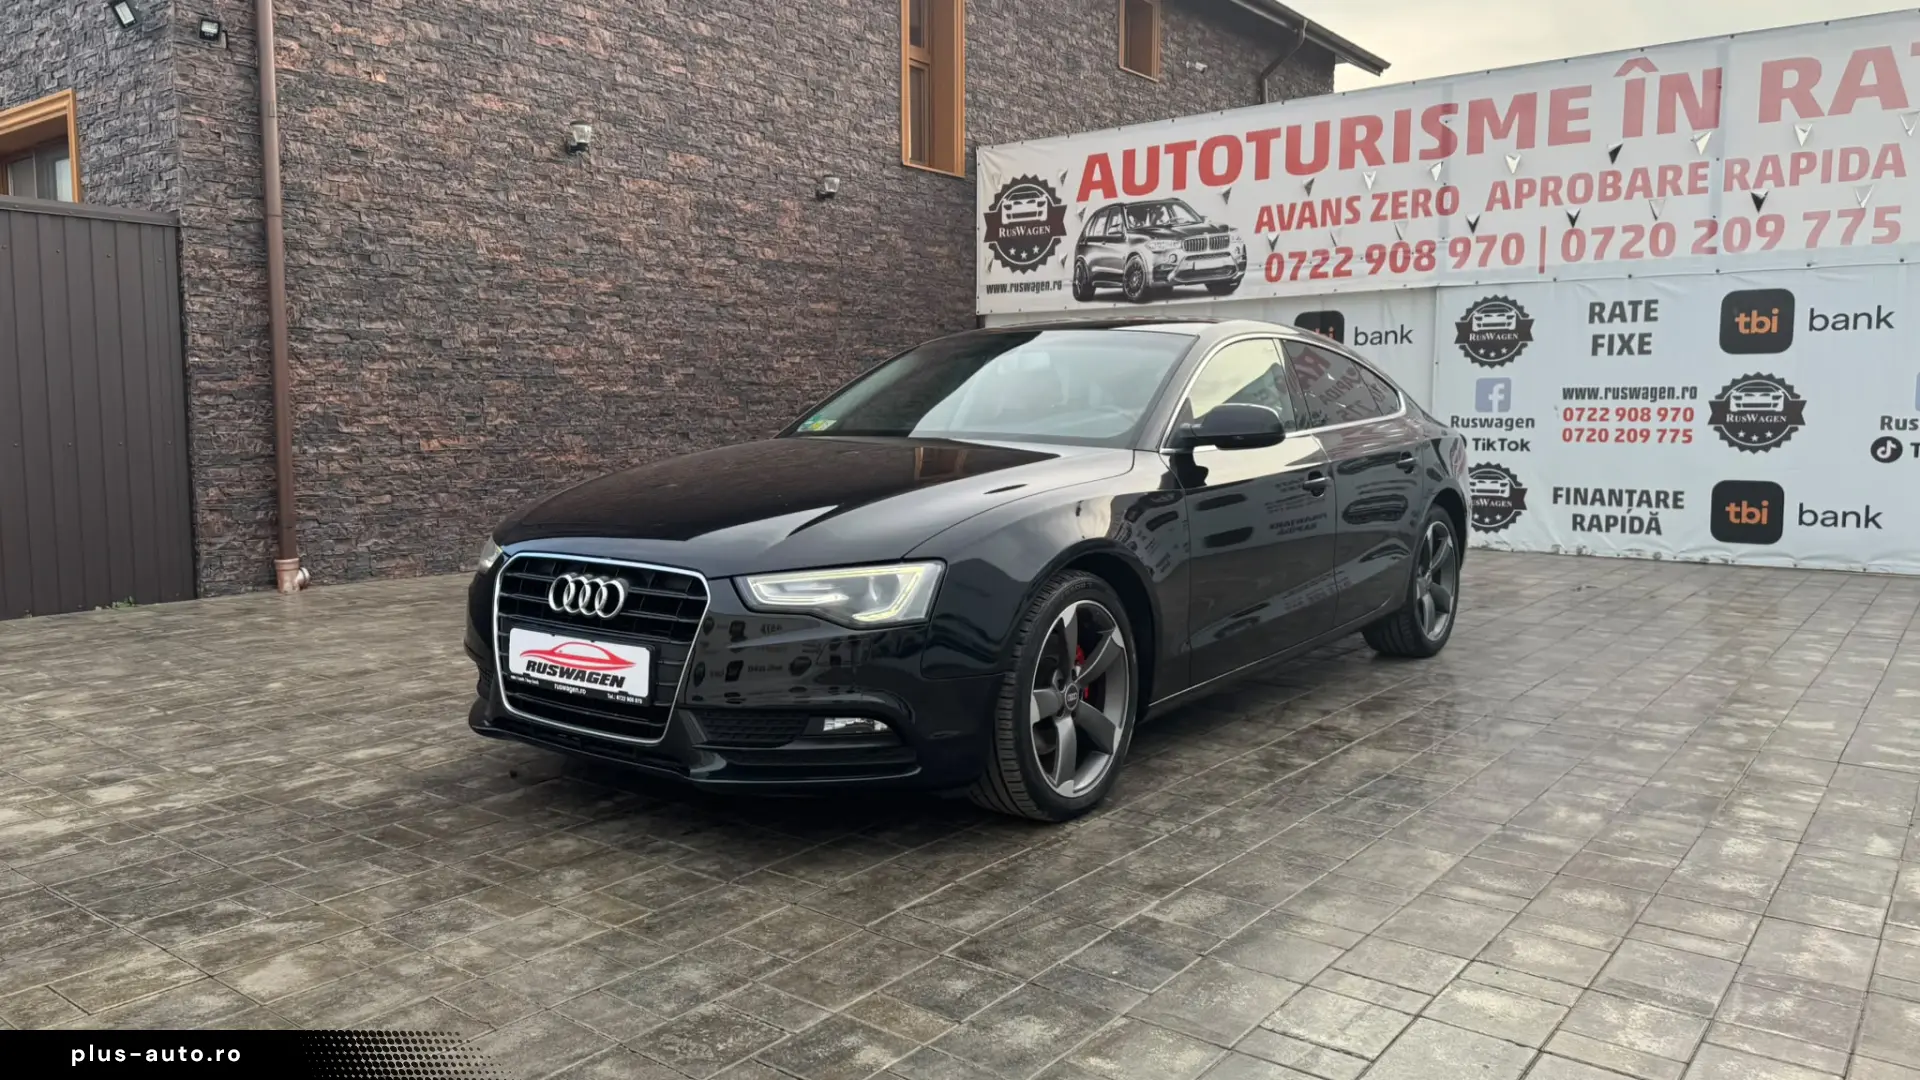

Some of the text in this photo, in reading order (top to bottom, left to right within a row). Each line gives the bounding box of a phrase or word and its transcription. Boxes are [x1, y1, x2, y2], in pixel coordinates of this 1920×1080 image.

[1076, 42, 1920, 201] AUTOTURISME ÎN RA
[1254, 143, 1906, 234] AVANS ZERO APROBARE RAPIDA
[1264, 246, 1354, 283] 0722
[1364, 240, 1437, 275] 908
[1448, 232, 1525, 269] 970
[1560, 222, 1676, 262] 0720
[1690, 213, 1785, 255] 209
[1802, 206, 1901, 249] 775
[986, 280, 1062, 295] www.ruswagen.ro
[1588, 299, 1659, 324] RATE
[1735, 305, 1895, 335] tbi bank
[1354, 324, 1414, 346] bank
[1591, 332, 1652, 356] FIXE
[1562, 386, 1698, 403] www.ruswagen.ro
[1450, 415, 1535, 431] Ruswagen
[1562, 407, 1695, 422] 0722 908 970
[1472, 438, 1531, 452] TikTok
[1562, 428, 1693, 444] 0720 209 775
[1572, 511, 1662, 536] RAPIDĂ
[1725, 500, 1883, 530] tbi bank
[525, 659, 626, 689] RUSWAGEN
